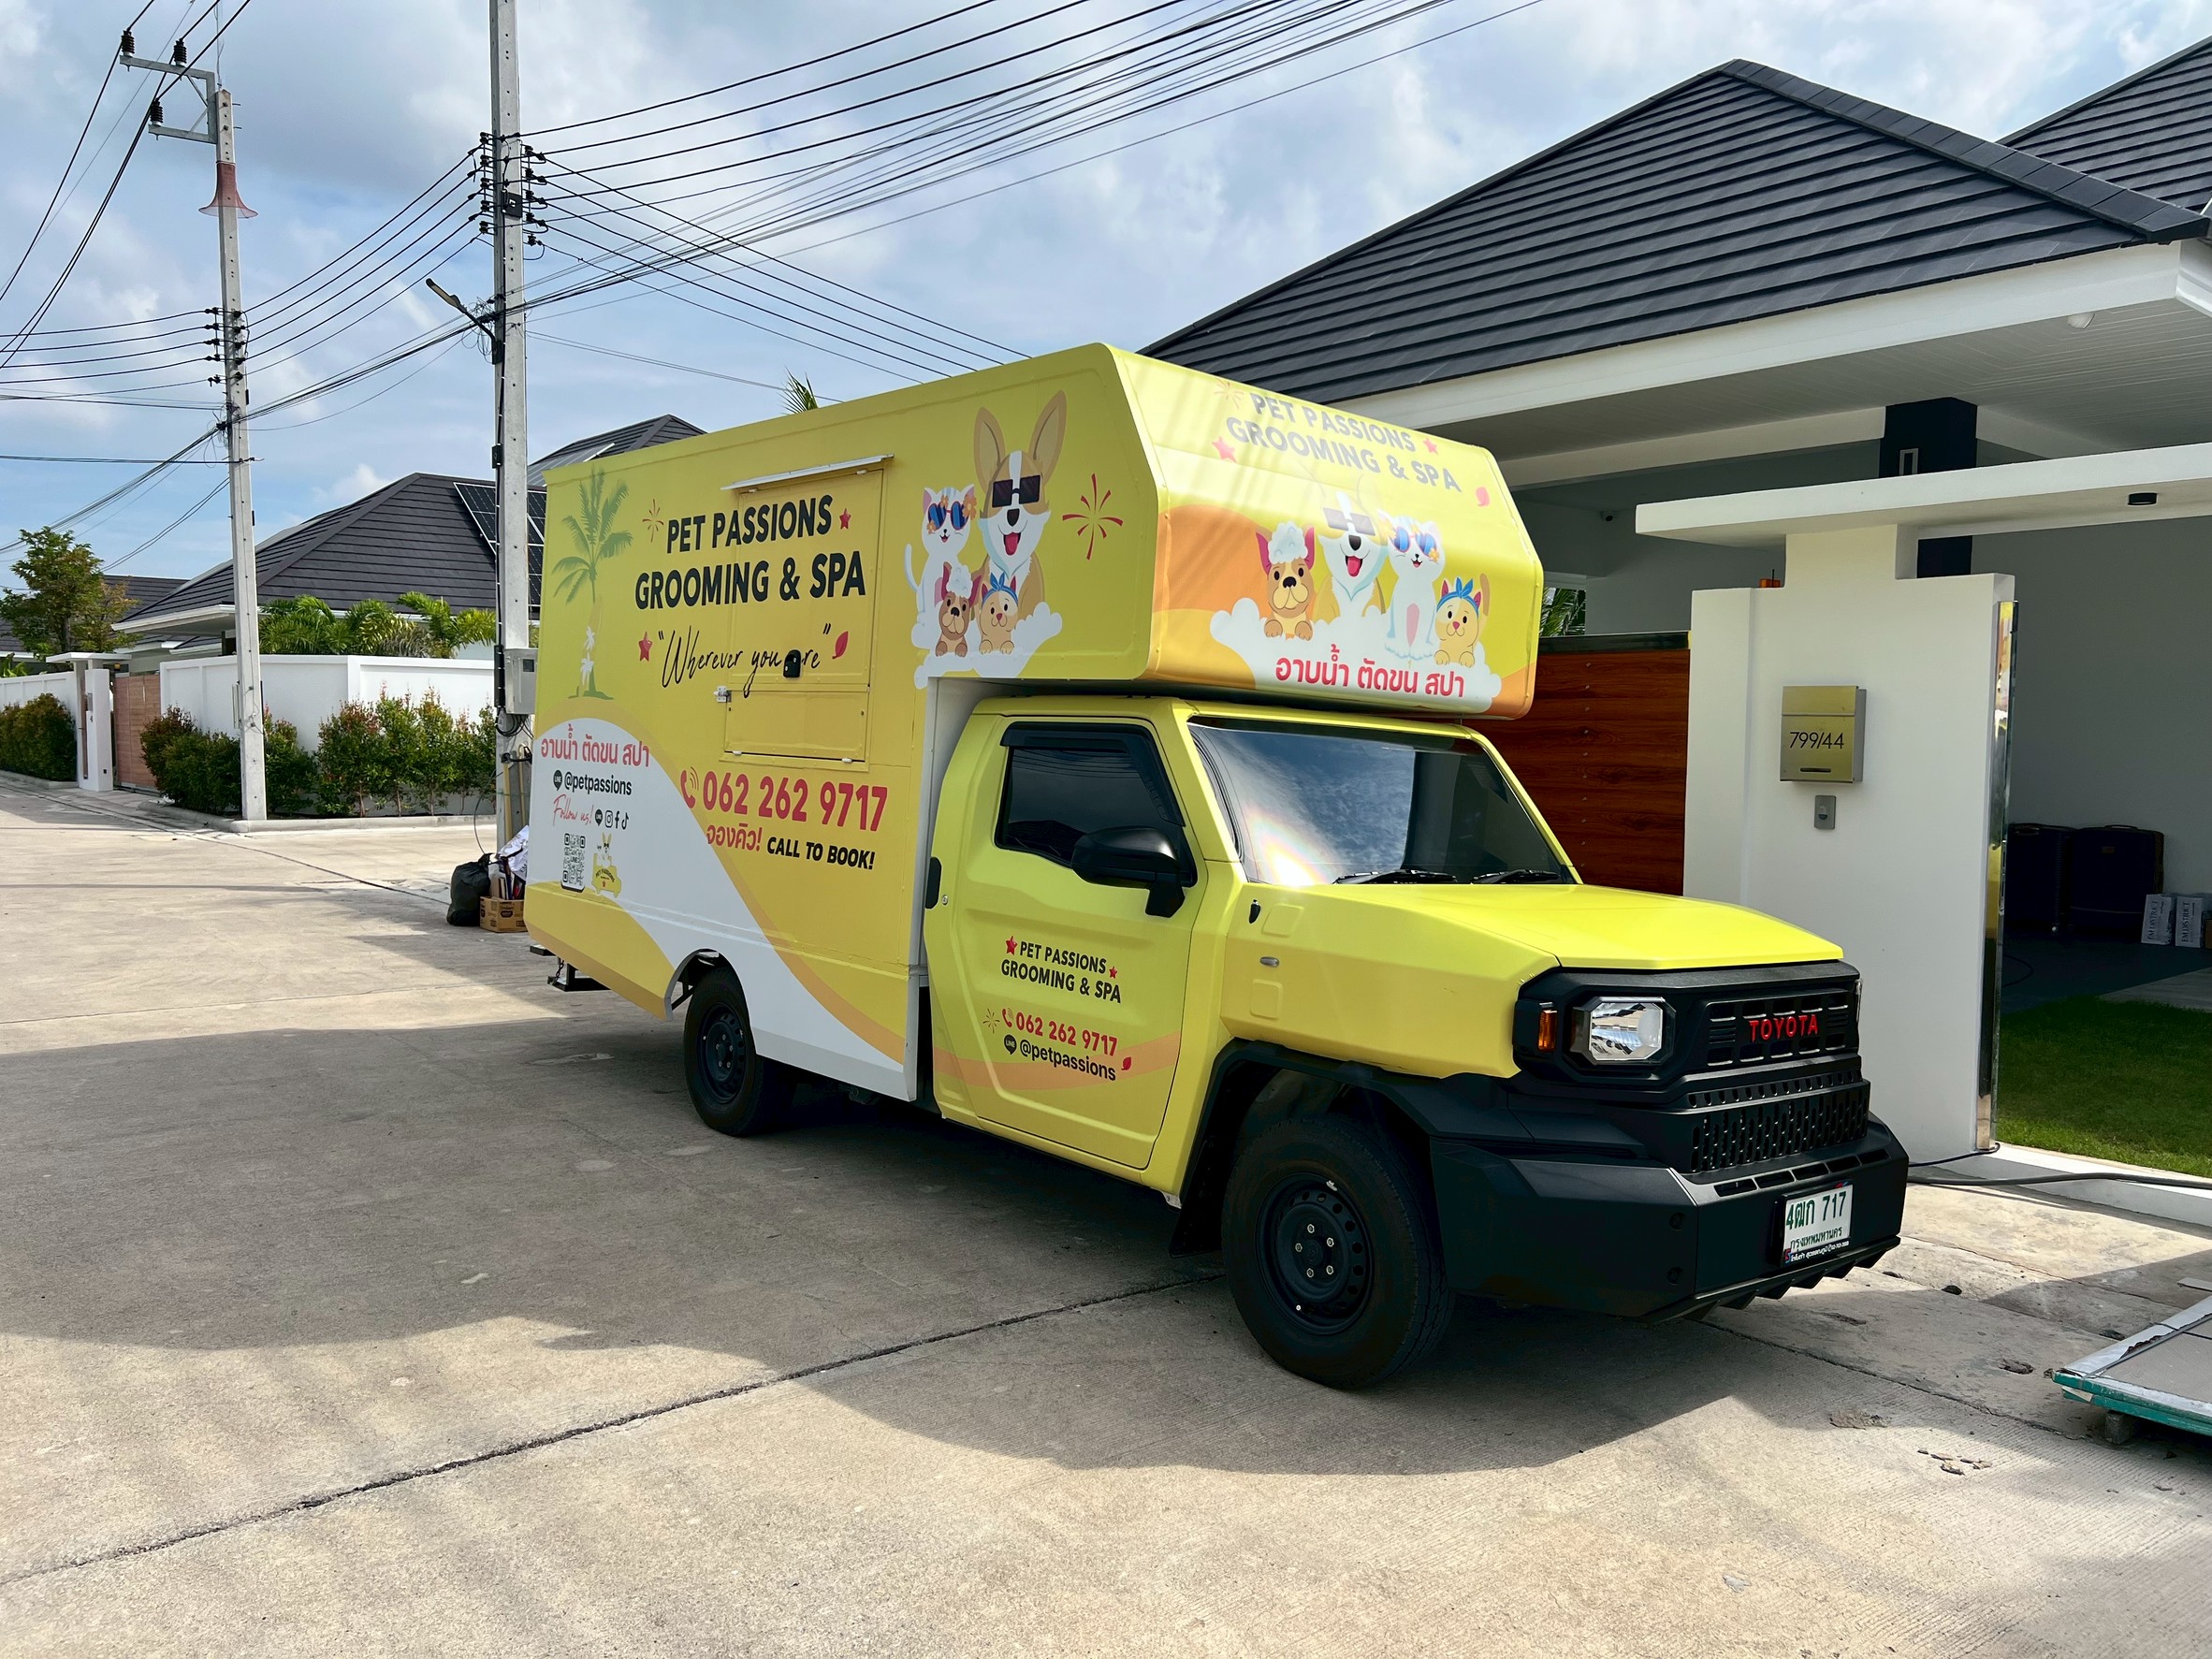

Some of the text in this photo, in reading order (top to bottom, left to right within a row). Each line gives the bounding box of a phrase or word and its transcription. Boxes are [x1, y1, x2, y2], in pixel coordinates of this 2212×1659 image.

[1250, 391, 1417, 453] PET PASSIONS
[1226, 416, 1463, 493] GROOMING & SPA
[666, 494, 834, 554] PET PASSIONS
[634, 550, 866, 610] GROOMING & SPA
[743, 650, 782, 698] you
[1275, 643, 1465, 698] อาบน้ำ ตัดขน สปา
[541, 723, 650, 767] อาบน้ำ ตัดขน สปา
[1789, 731, 1844, 749] 799/44
[564, 771, 633, 795] @petpassions
[703, 770, 889, 833] 062 262 9717
[553, 793, 578, 826] Follow
[706, 822, 763, 851] จองคิว!
[767, 837, 876, 870] CALL TO BOOK!
[1019, 940, 1107, 975] PET PASSIONS
[1001, 959, 1121, 1004] GROOMING & SPA
[1015, 1011, 1118, 1056] 062 262 9717
[1748, 1013, 1819, 1043] TOYOTA
[1019, 1039, 1116, 1082] @petpassions
[1822, 1191, 1847, 1221] 717
